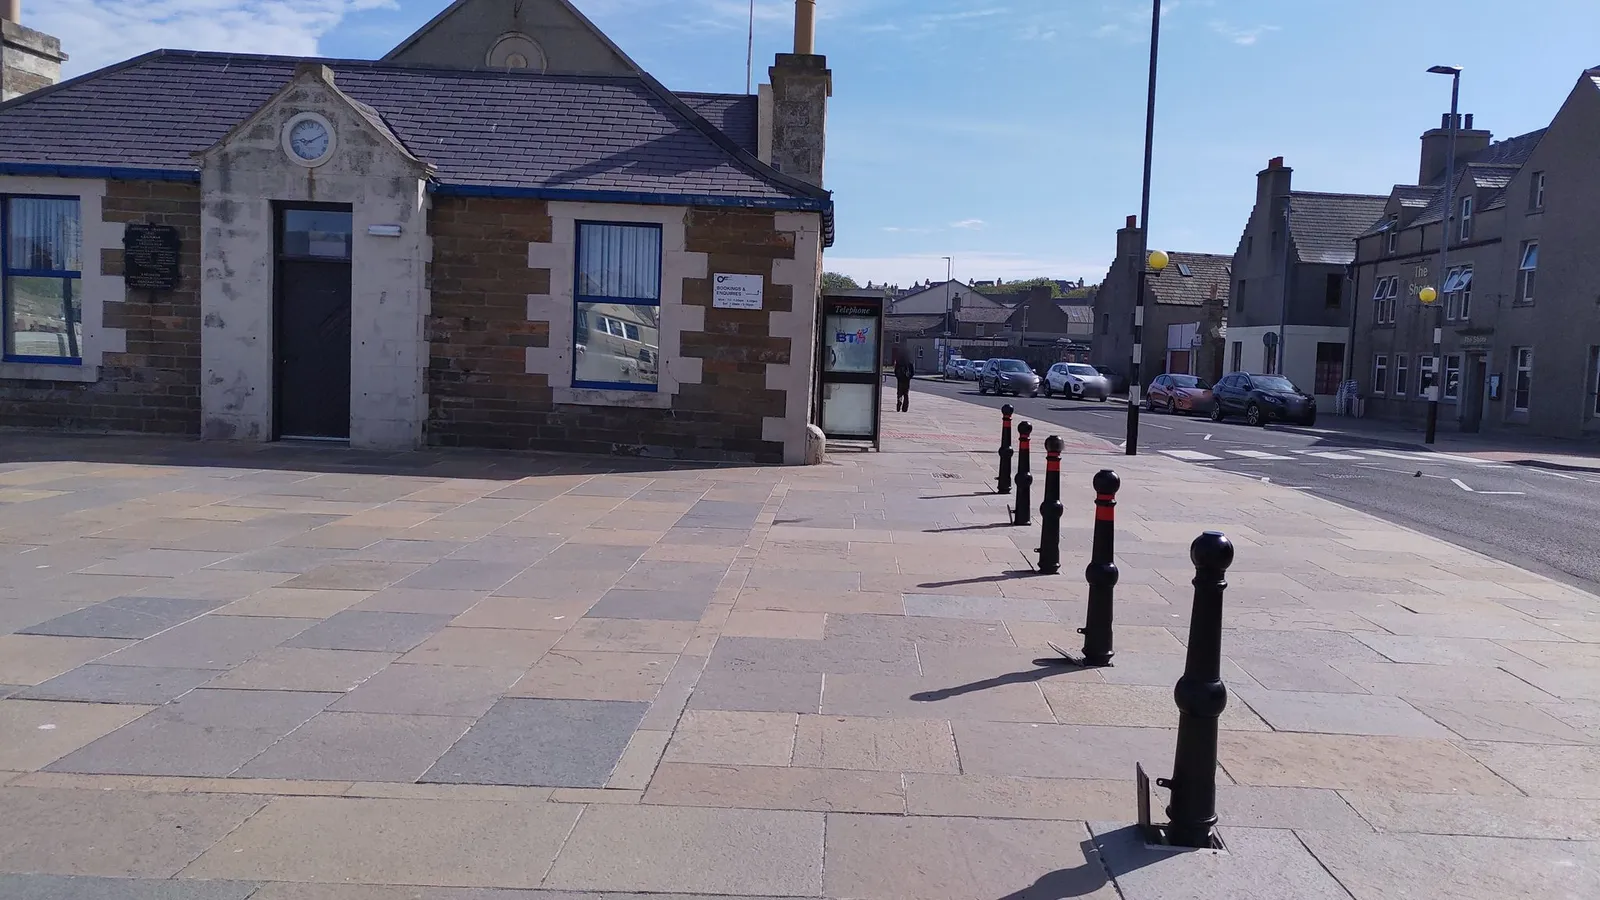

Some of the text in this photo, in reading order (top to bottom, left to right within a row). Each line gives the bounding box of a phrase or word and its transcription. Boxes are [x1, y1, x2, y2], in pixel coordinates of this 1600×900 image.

[1414, 266, 1428, 277] The
[835, 305, 871, 315] Telephone
[835, 332, 857, 343] BT
